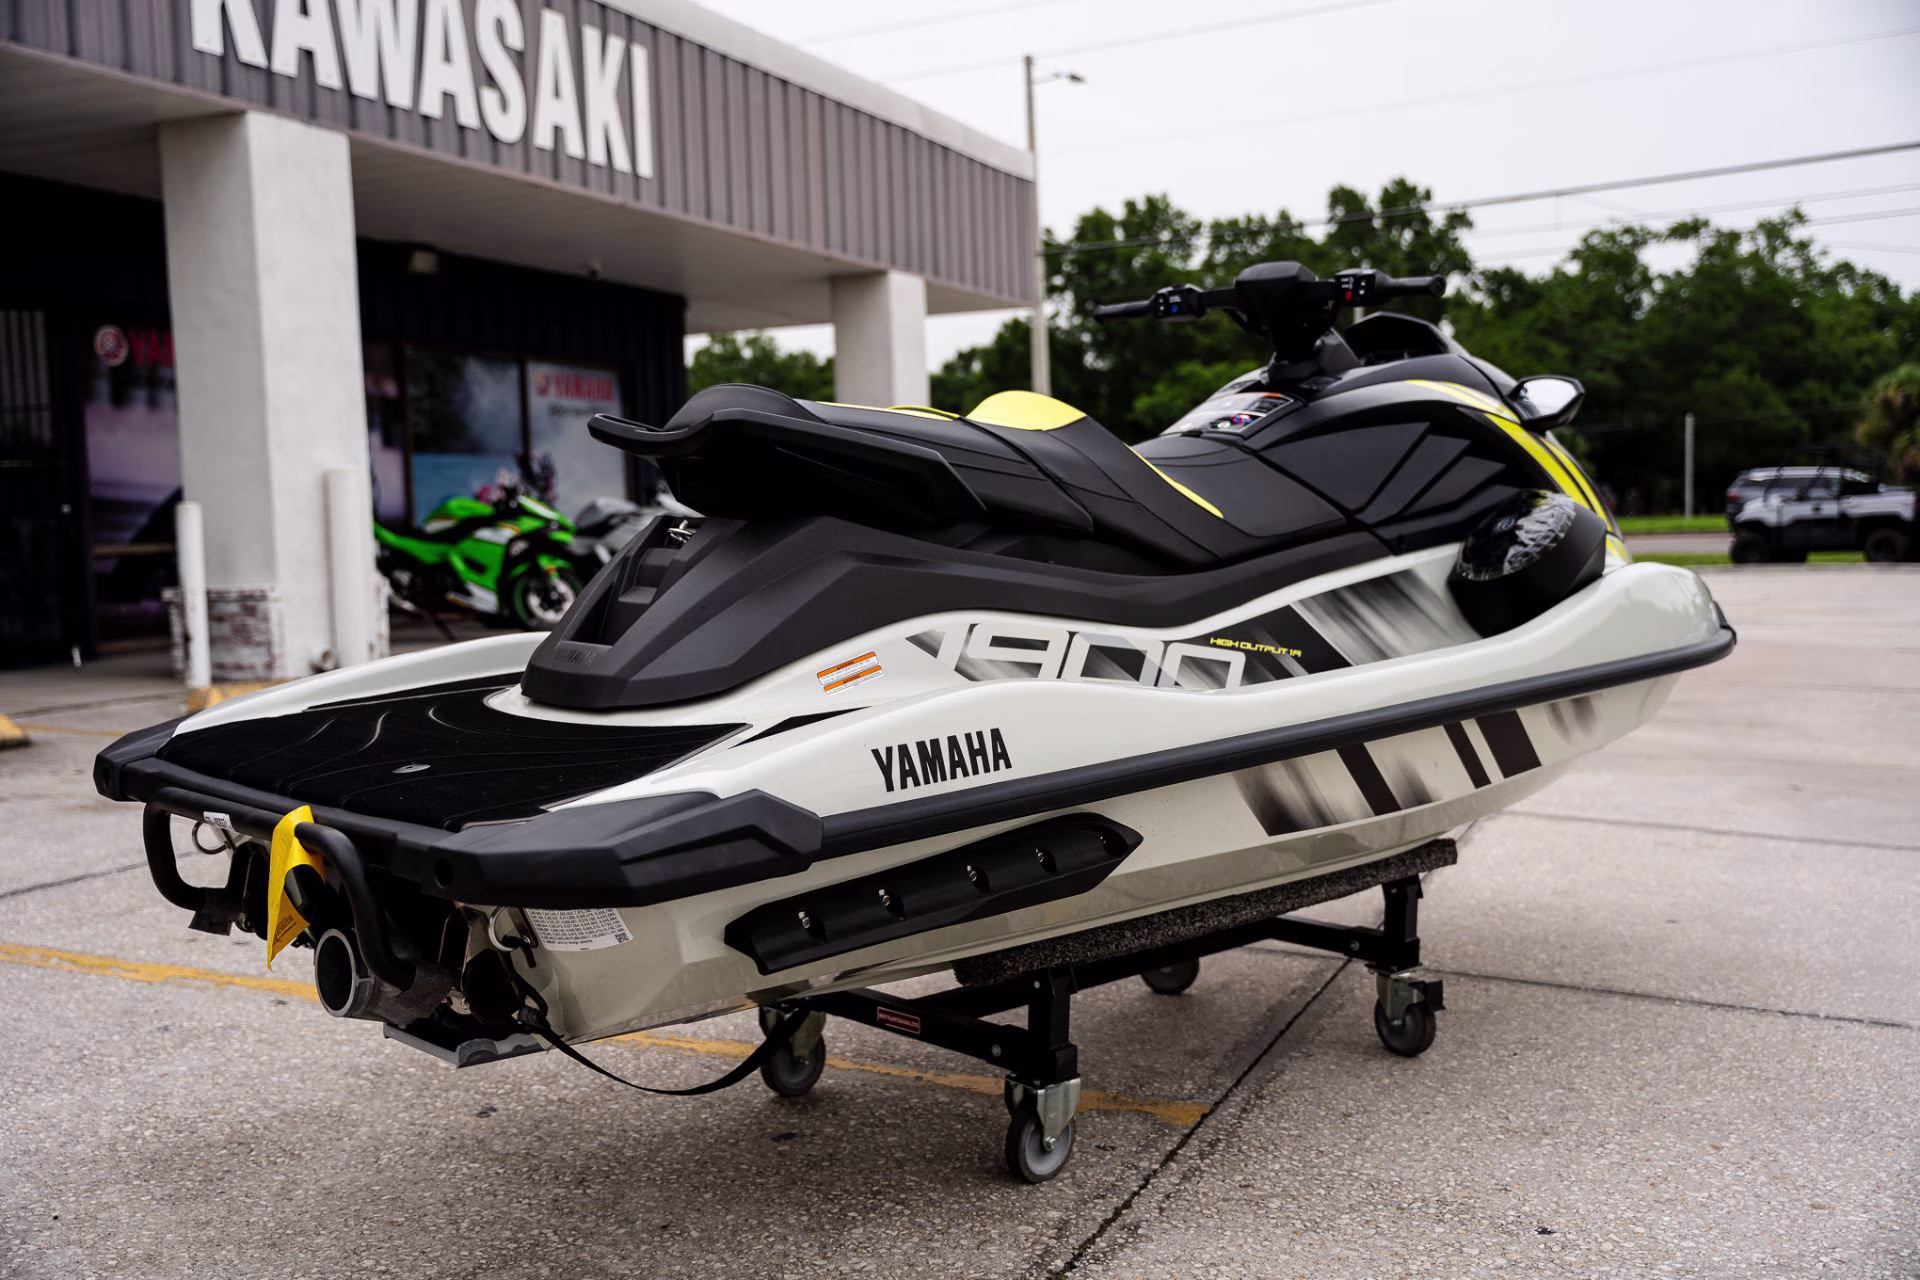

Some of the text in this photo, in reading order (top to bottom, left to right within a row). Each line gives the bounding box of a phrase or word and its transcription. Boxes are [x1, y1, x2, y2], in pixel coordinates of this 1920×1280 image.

[1210, 637, 1239, 648] HIGH
[1240, 641, 1288, 654] OUTPUT
[871, 728, 1012, 792] YAMAHA
